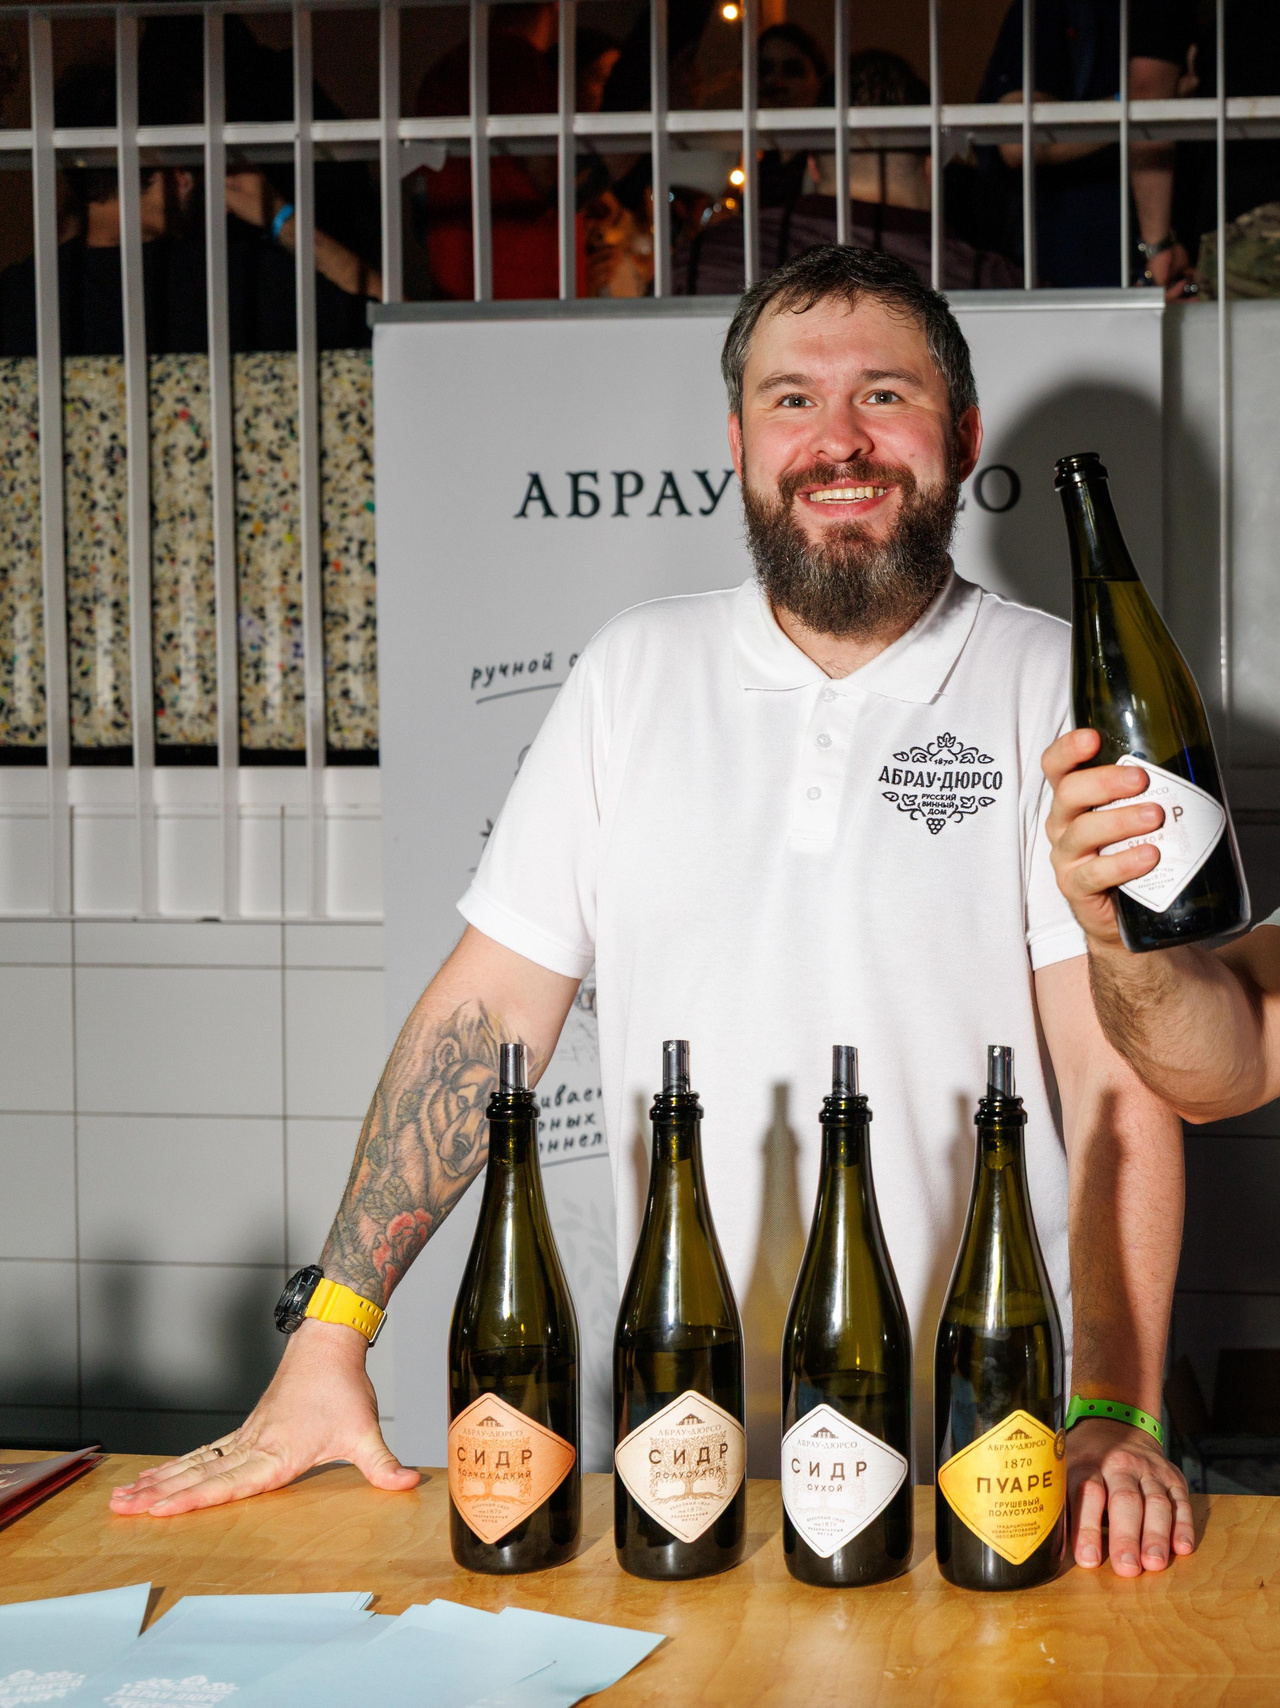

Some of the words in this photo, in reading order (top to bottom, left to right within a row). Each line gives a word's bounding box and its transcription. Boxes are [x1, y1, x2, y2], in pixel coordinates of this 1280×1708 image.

[470, 652, 554, 689] ручной
[933, 757, 955, 767] 1870
[921, 793, 957, 801] РУССКИЙ
[921, 800, 955, 809] ВИННЫЙ
[927, 808, 947, 816] ДОМ
[457, 1446, 533, 1469] СИДР
[648, 1442, 728, 1466] СИДР
[791, 1458, 867, 1481] СИДР
[1004, 1458, 1033, 1469] 1870
[655, 1465, 721, 1480] ПОЛУСУХОЙ
[806, 1483, 843, 1493] СУХОЙ
[976, 1470, 1053, 1494] ПУАРЕ
[994, 1496, 1040, 1509] ГРУШЕВЫЙ
[988, 1505, 1044, 1517] ПОЛУСУХОЙ
